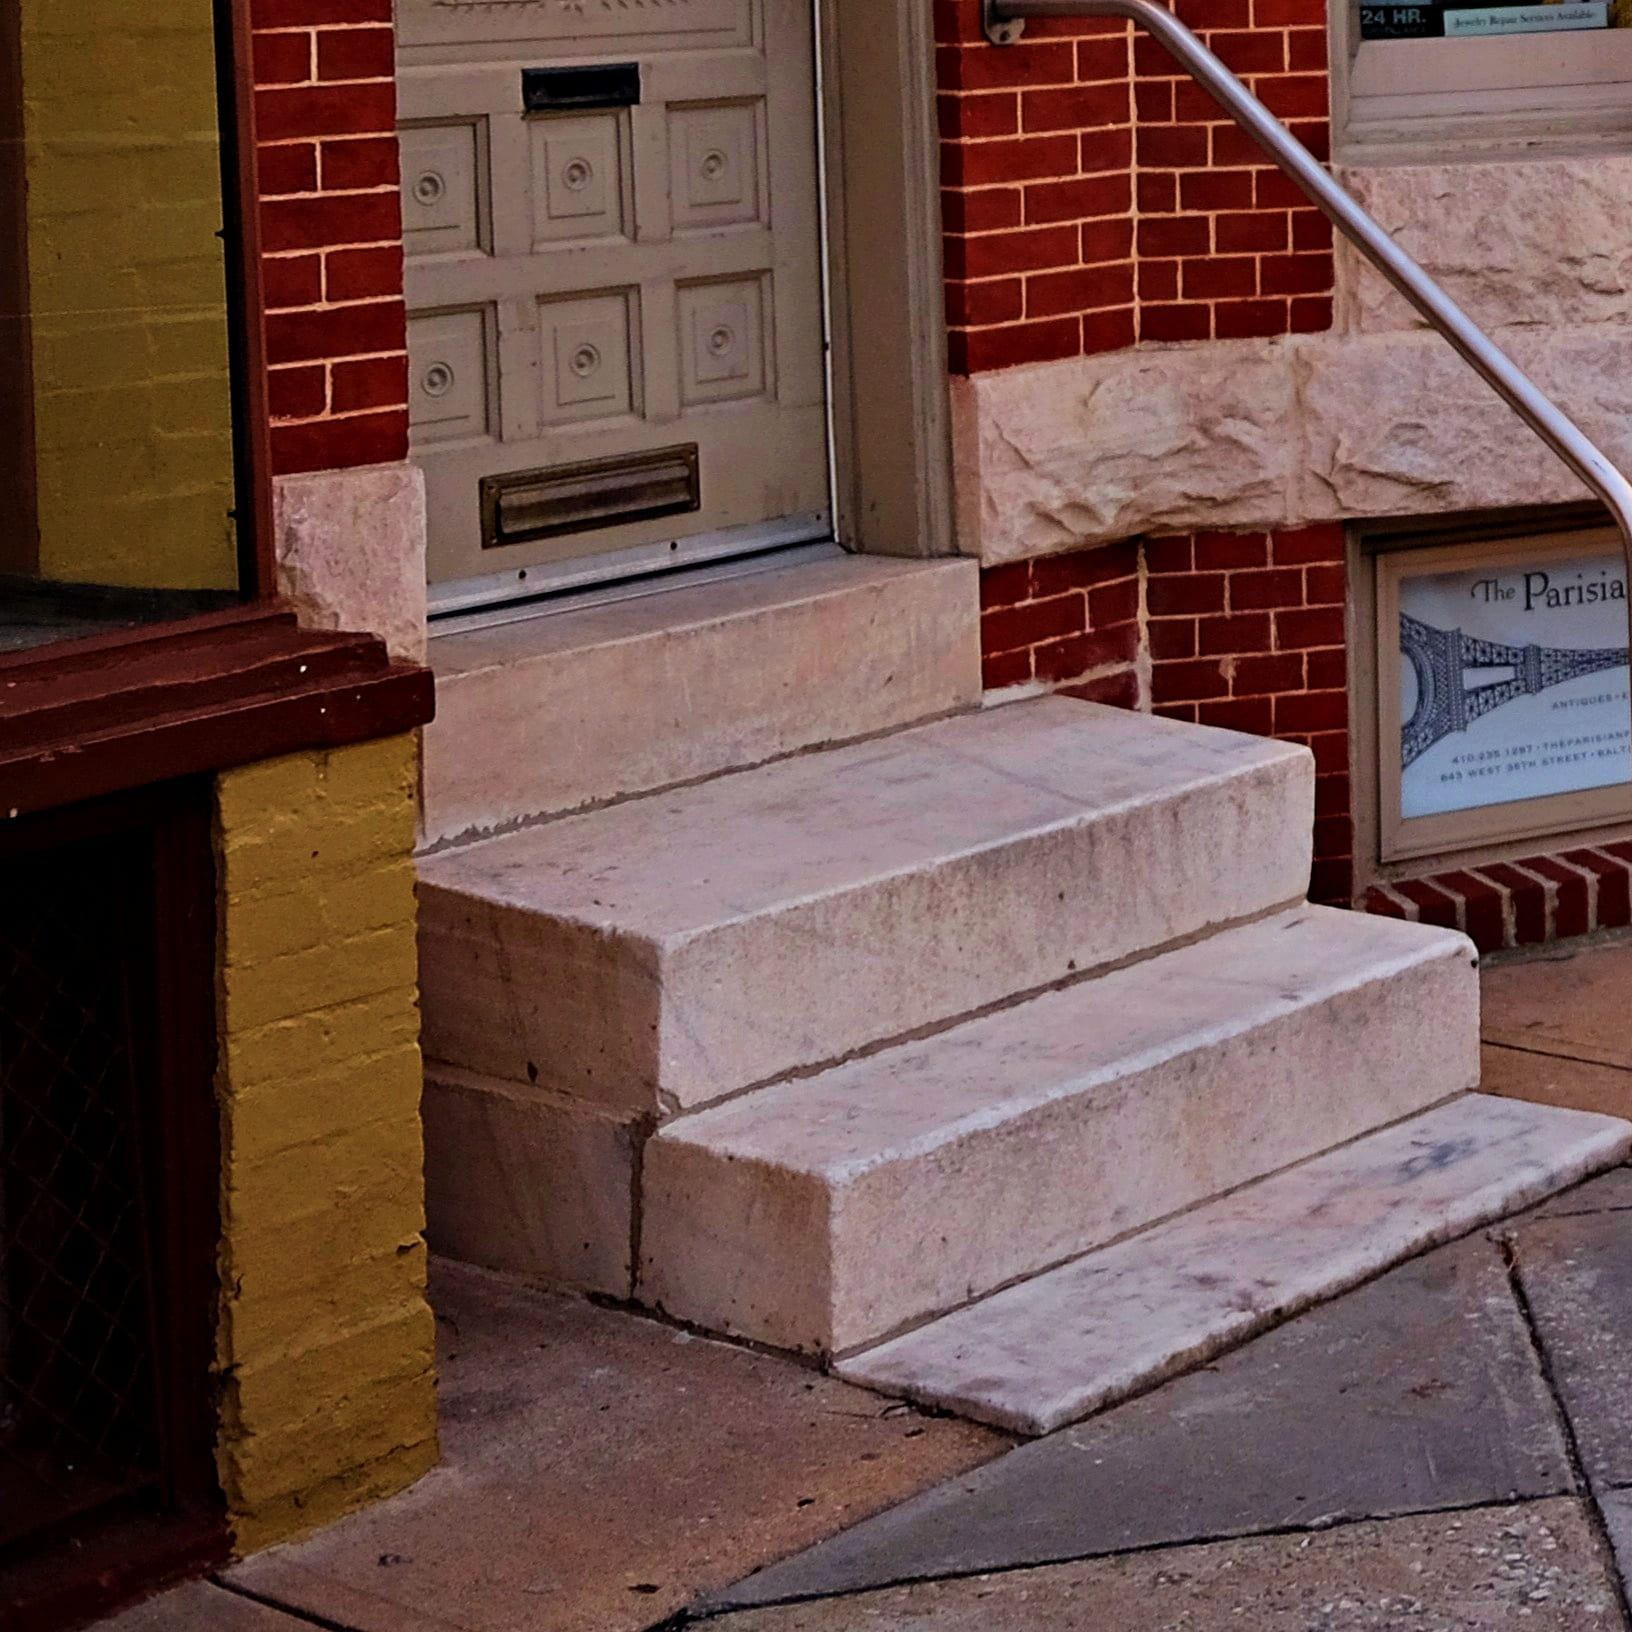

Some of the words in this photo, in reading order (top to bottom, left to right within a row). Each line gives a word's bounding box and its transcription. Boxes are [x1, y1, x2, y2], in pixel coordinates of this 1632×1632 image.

[1362, 9, 1385, 25] 24
[1392, 8, 1427, 24] HR.
[1470, 577, 1516, 603] The
[1523, 571, 1626, 611] Parisia
[1551, 692, 1613, 711] ANTIQUES
[1541, 752, 1588, 768] STREET
